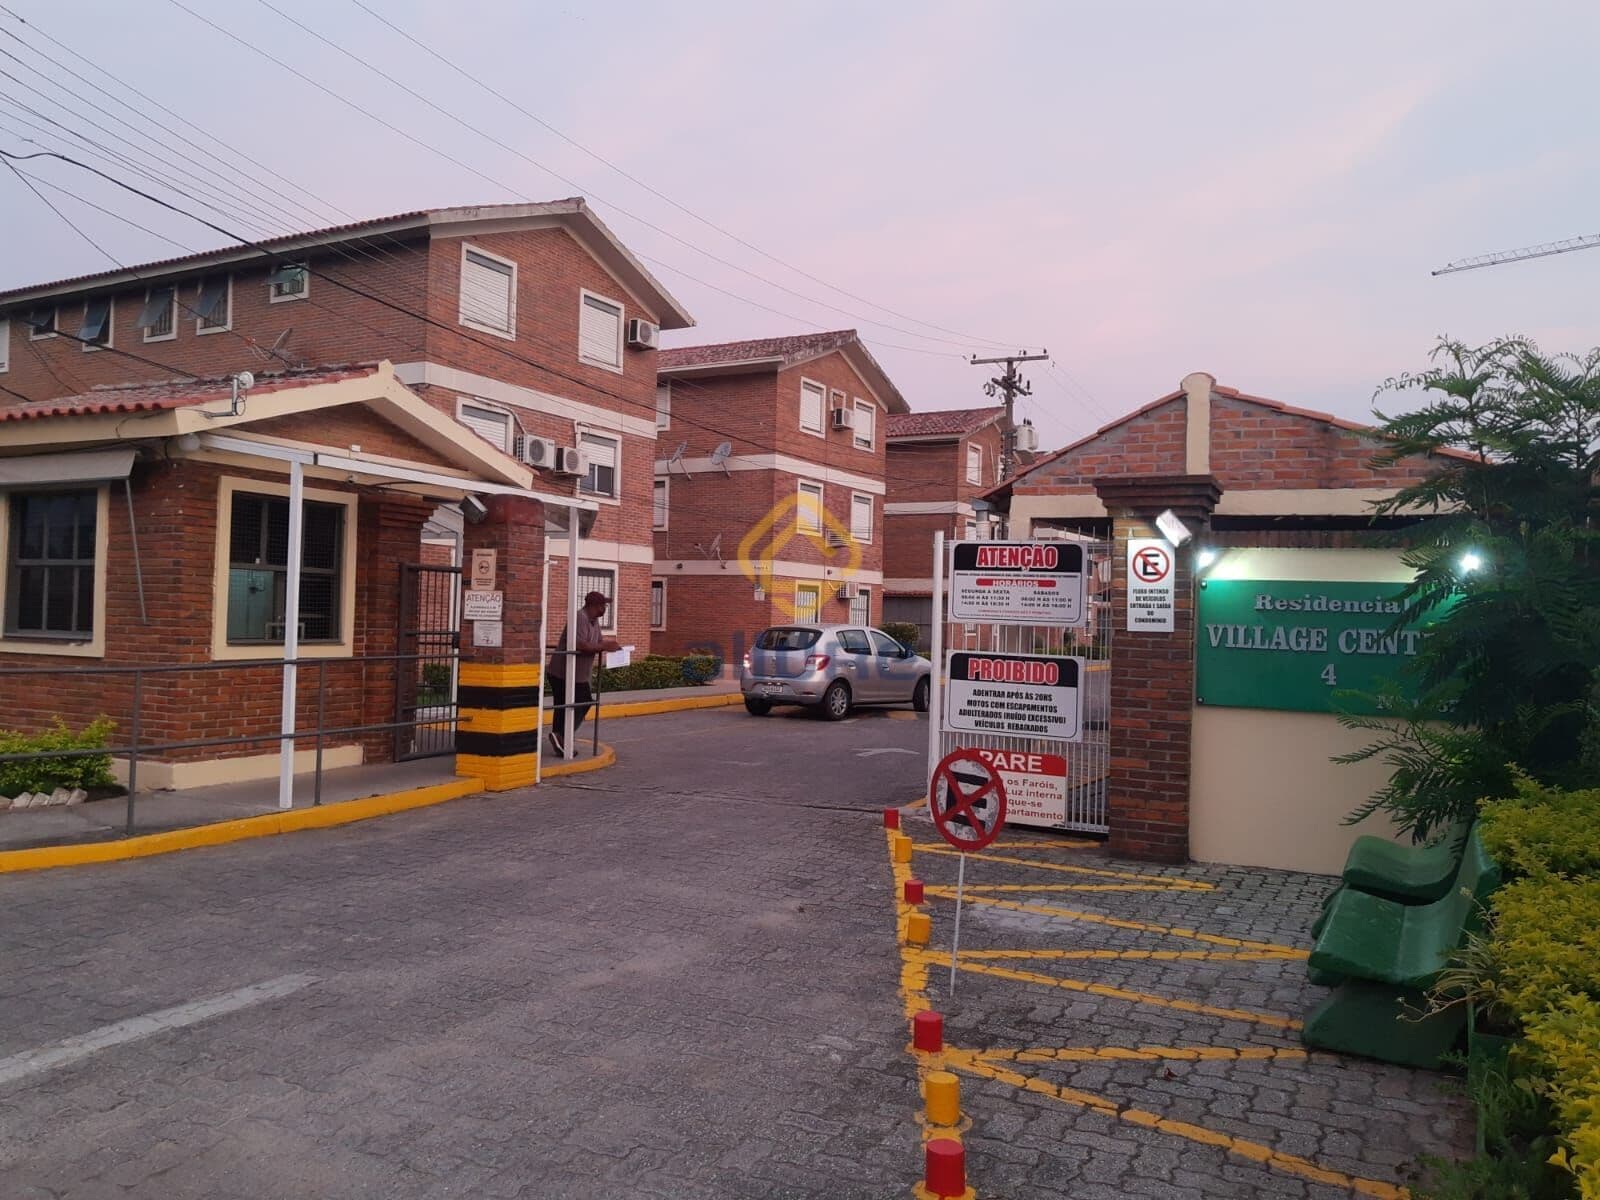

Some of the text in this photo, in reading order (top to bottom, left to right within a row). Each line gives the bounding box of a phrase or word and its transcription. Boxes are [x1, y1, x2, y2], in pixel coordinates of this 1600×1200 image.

[976, 543, 1058, 571] ATENÇÃO
[992, 579, 1039, 588] HORÁRIOS
[466, 593, 501, 603] ATENÇÃO
[1255, 593, 1410, 614] Residencial
[1206, 624, 1430, 655] VILLAGE CENT
[968, 657, 1059, 686] PROIBIDO
[1321, 664, 1337, 685] 4
[972, 689, 1006, 699] ADENTRAR
[1006, 689, 1024, 700] APÓS
[1035, 693, 1053, 701] 20HS
[967, 699, 1058, 713] MOTOS COM ESCAPAMENTOS
[958, 708, 1002, 719] ADULTERADOS
[974, 719, 1049, 733] VEÍCULOS REBAIXADOS
[1022, 778, 1058, 791] Faróis,
[1026, 789, 1063, 800] interna
[1008, 798, 1043, 808] que-se
[1006, 808, 1064, 821] partamento
